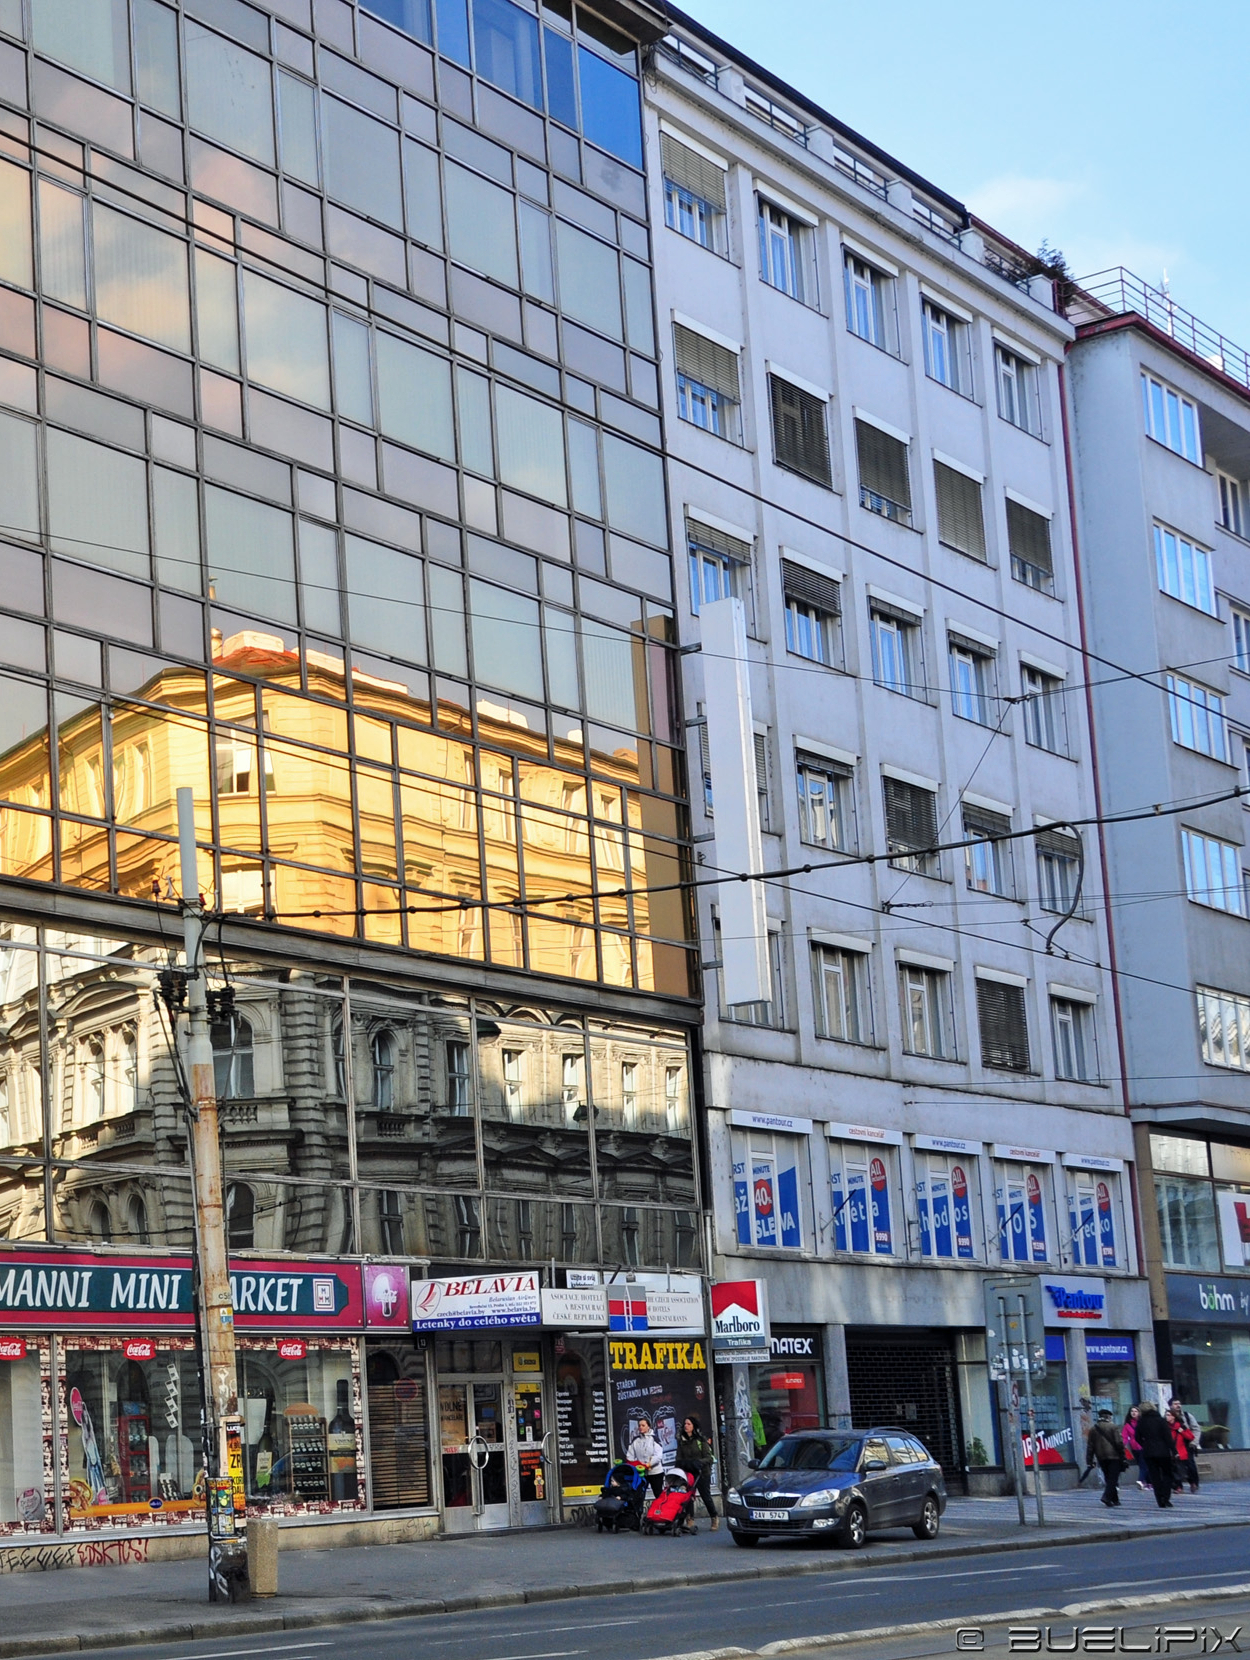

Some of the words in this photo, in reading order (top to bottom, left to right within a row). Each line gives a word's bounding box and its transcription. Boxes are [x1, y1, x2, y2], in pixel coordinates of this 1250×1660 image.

[752, 1115, 793, 1128] www.pantour.cz
[848, 1128, 866, 1137] cestovní
[931, 1138, 966, 1150] www.pantour.cz
[733, 1162, 745, 1174] RST
[752, 1165, 771, 1175] MINUTE
[870, 1160, 882, 1176] All
[1081, 1157, 1110, 1167] www.pantour.cz
[848, 1175, 864, 1186] MINUTE
[952, 1168, 962, 1183] All
[931, 1182, 947, 1192] MINUTE
[1027, 1176, 1036, 1191] All
[755, 1211, 796, 1239] SLEVA
[919, 1203, 969, 1233] hodos
[110, 1272, 182, 1310] MINI
[229, 1276, 303, 1312] ARKET
[443, 1275, 536, 1297] BELAVIA
[1058, 1286, 1105, 1310] Pantour
[1199, 1283, 1236, 1311] böhm
[436, 1308, 485, 1318] czech@belavia.by
[491, 1306, 537, 1315] www.belavia.by
[573, 1313, 605, 1321] REPUBLIKY
[416, 1321, 456, 1330] Letenky
[458, 1317, 471, 1327] do
[473, 1315, 507, 1326] celého
[510, 1314, 537, 1323] světa
[715, 1316, 760, 1334] Marlboro
[727, 1338, 752, 1346] Trafika
[126, 1343, 151, 1357] Coca-Cola
[280, 1343, 302, 1356] Coca-Cola
[609, 1341, 707, 1370] TRAFIKA
[1086, 1344, 1128, 1356] www.pantour.cz
[1022, 1430, 1046, 1459] IRST
[1044, 1427, 1073, 1450] MINUTE
[754, 1511, 766, 1519] 2AV
[769, 1511, 786, 1519] 5747
